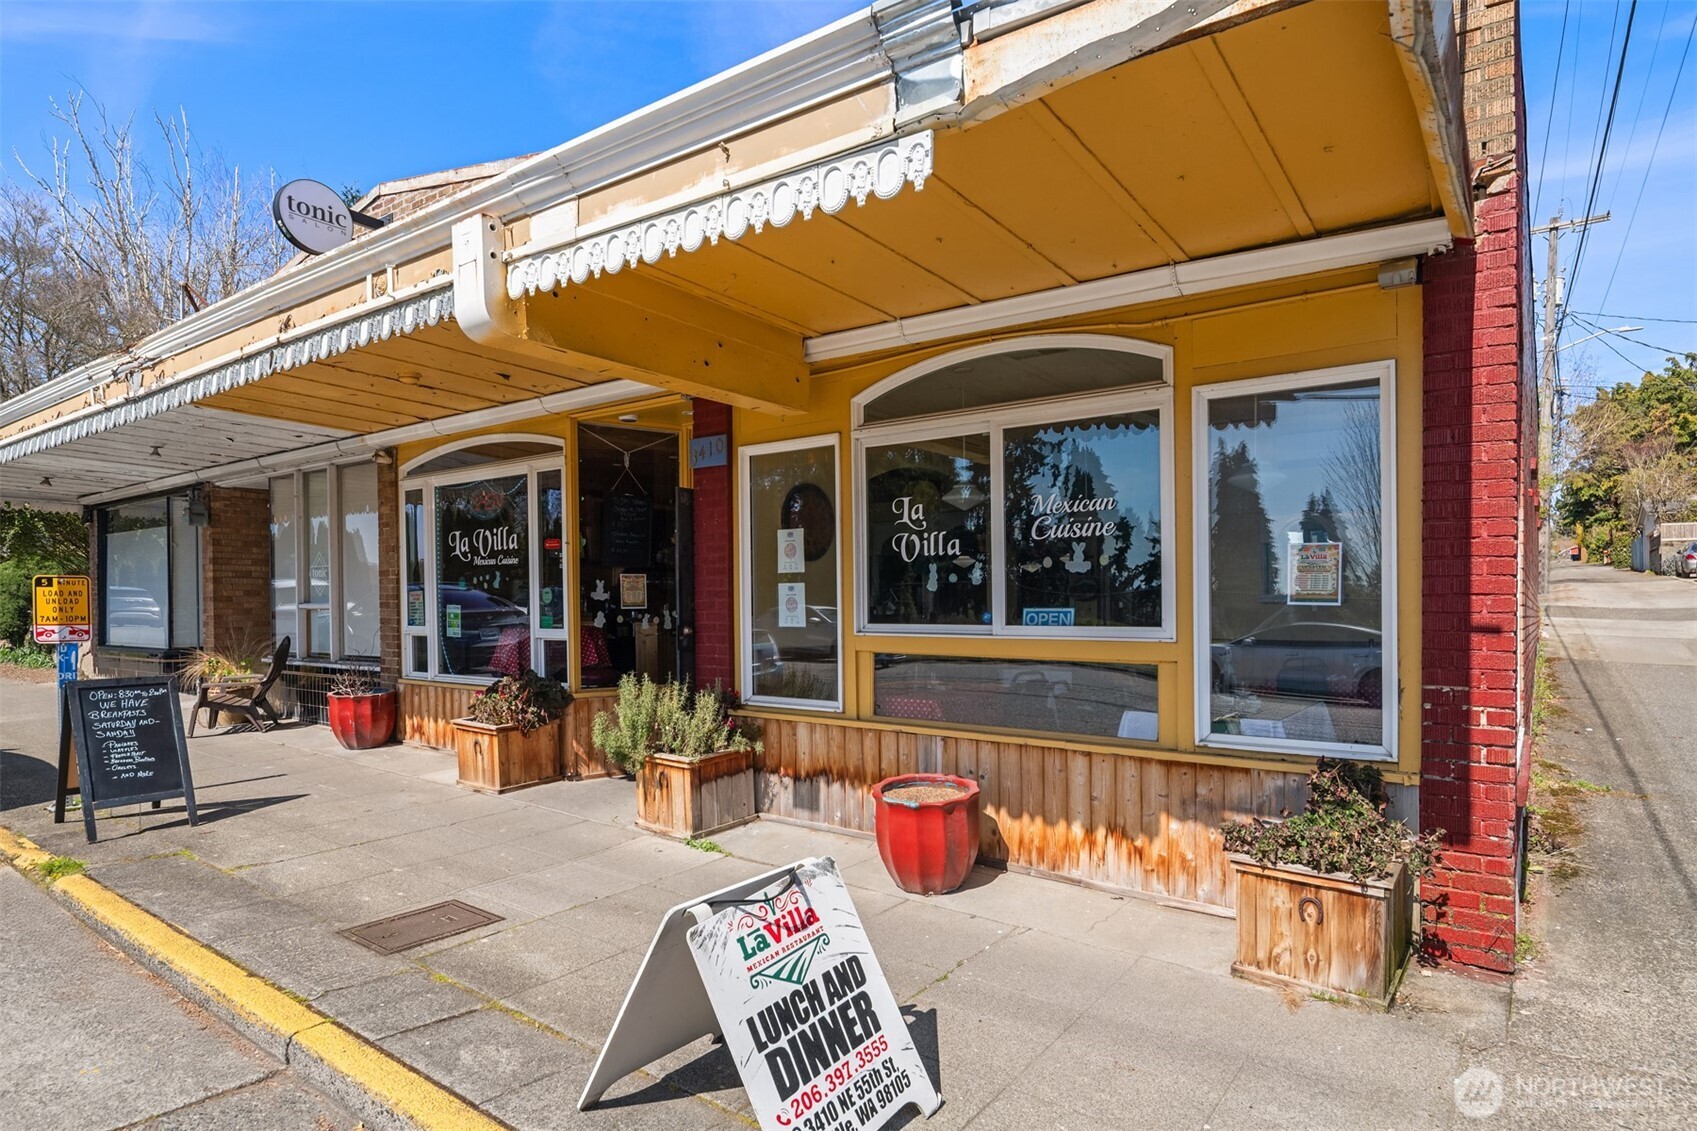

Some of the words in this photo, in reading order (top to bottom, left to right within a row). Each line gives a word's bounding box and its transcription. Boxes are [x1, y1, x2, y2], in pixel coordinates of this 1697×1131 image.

[287, 195, 347, 229] tonic
[288, 213, 347, 236] SALON
[892, 496, 927, 530] La
[1031, 493, 1117, 515] Mexican
[1031, 515, 1117, 540] Cuisine
[448, 530, 471, 562] La
[473, 526, 519, 557] Villa
[892, 531, 961, 562] Villa
[473, 555, 496, 566] Mexican
[497, 554, 519, 565] Cuisine
[42, 589, 64, 597] LOAD
[67, 589, 83, 597] AND
[1026, 612, 1071, 626] OPEN
[88, 710, 147, 719] BREAKFASTS
[100, 701, 117, 709] WE
[121, 698, 149, 708] HAVE
[92, 719, 136, 730] SATURDAY
[746, 950, 780, 973] MEXICAN
[781, 925, 824, 954] RESTAURANT
[746, 978, 827, 1054] LUNCH
[821, 954, 867, 1007] AND
[764, 990, 882, 1103] DINNER
[790, 1034, 889, 1119] 206.397.3555
[803, 1100, 839, 1131] 3410
[837, 1087, 857, 1115] NE
[853, 1066, 884, 1101] 55th
[855, 1097, 879, 1127] WA
[875, 1069, 912, 1109] 98105
